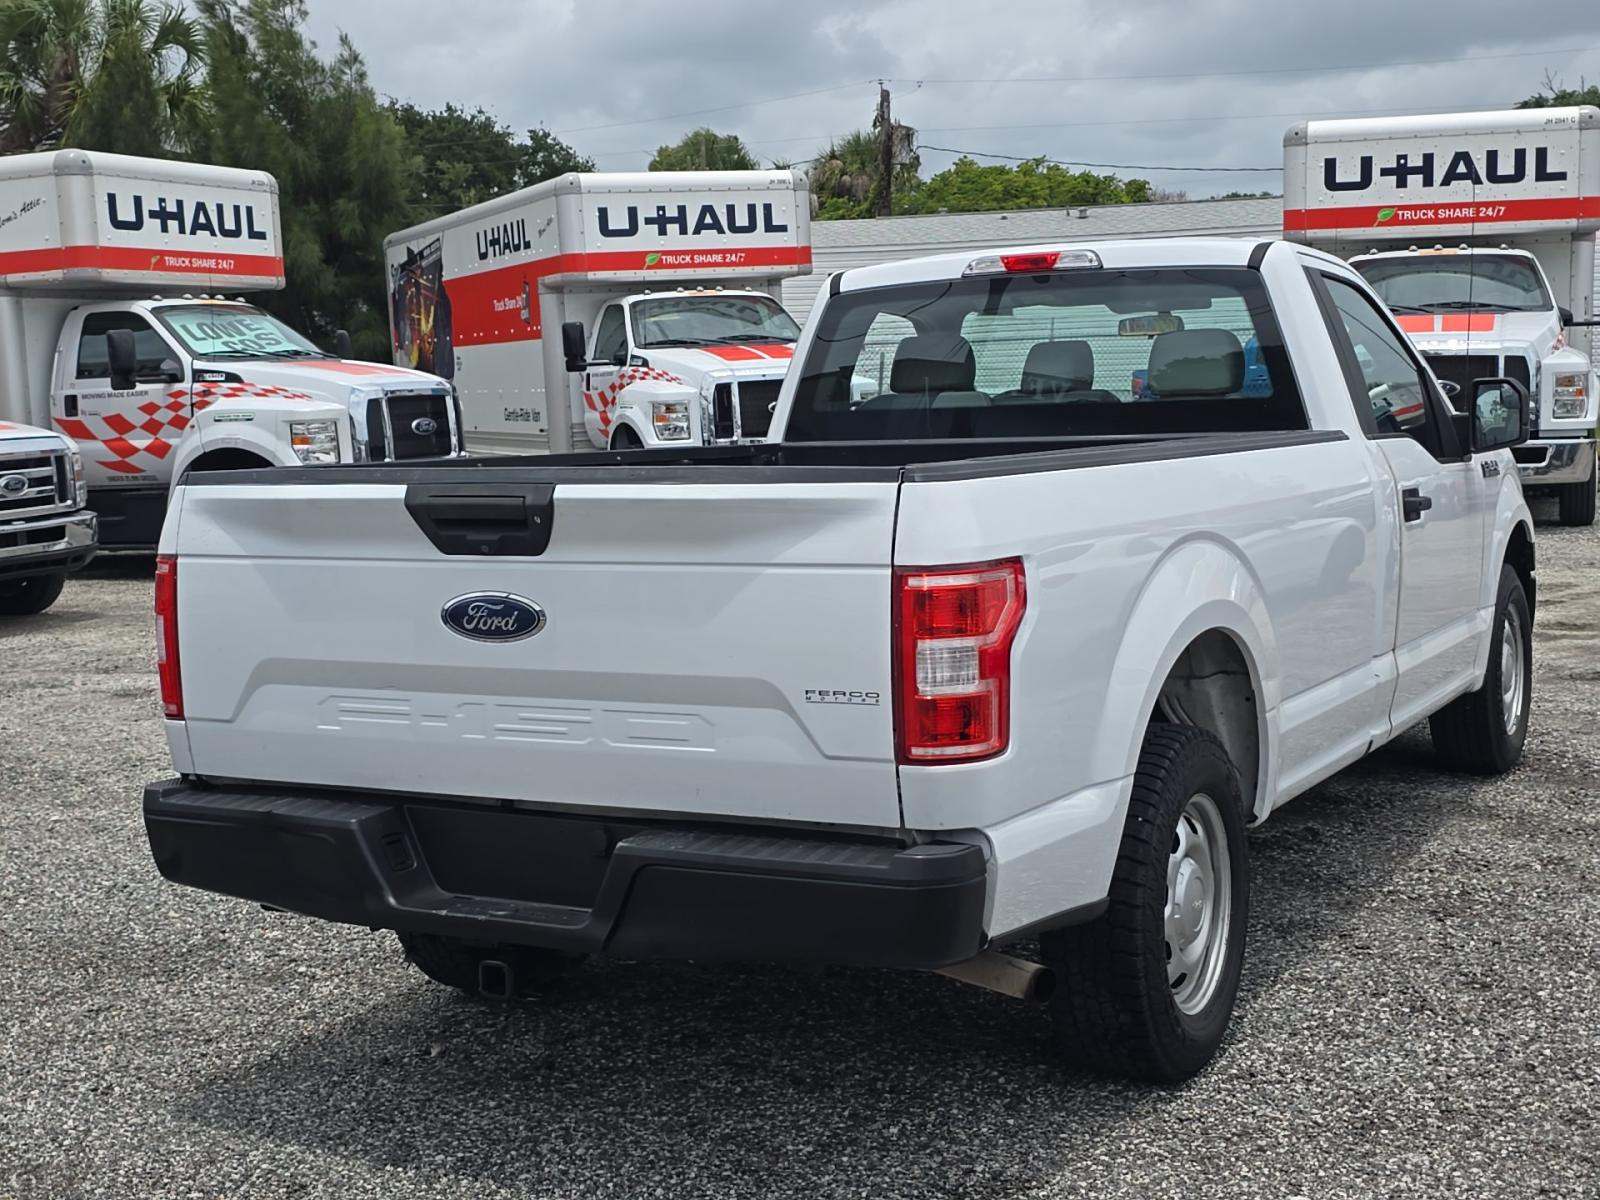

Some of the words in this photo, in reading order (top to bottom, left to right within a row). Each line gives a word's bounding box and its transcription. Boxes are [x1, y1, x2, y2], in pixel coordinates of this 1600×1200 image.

[1324, 146, 1568, 192] U-HAUL
[106, 192, 268, 241] U-HAUL
[597, 202, 789, 238] U-HAUL
[1397, 209, 1435, 221] TRUCK
[1437, 207, 1477, 219] SHARE
[1478, 205, 1507, 218] 24/7
[475, 218, 532, 261] U-HAUL
[164, 256, 190, 267] TRUCK
[191, 258, 217, 269] SHARE
[217, 259, 235, 270] 24/7
[661, 255, 692, 265] TRUCK
[693, 254, 724, 264] SHARE
[724, 252, 746, 263] 24/7
[463, 602, 518, 631] Ford
[805, 689, 880, 699] FERCO
